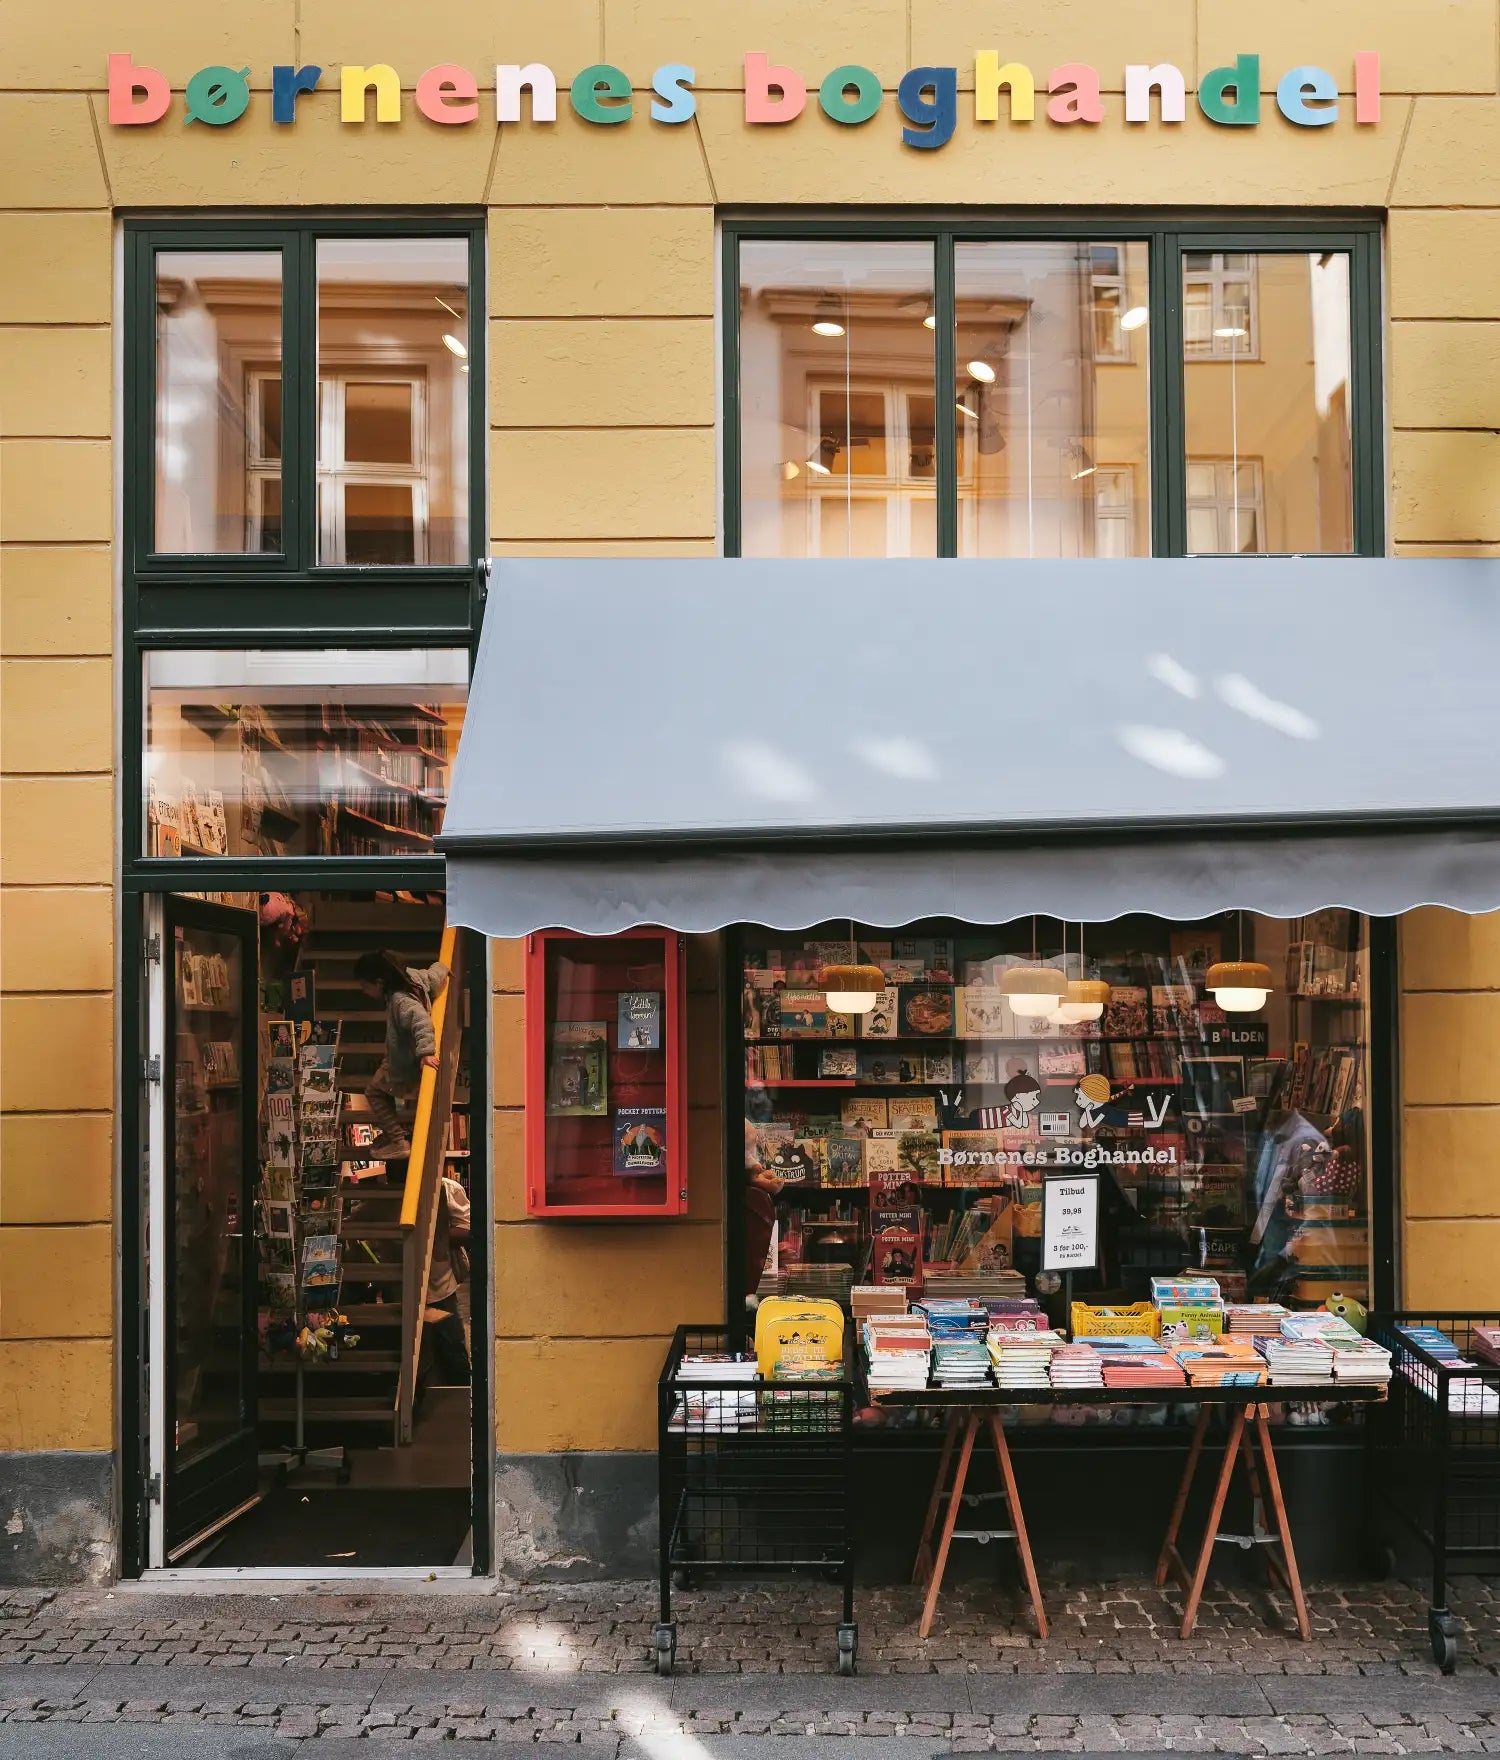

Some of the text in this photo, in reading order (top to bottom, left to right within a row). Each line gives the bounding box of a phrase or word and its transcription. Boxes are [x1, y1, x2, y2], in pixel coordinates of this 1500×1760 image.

[108, 50, 1380, 148] børnenes boghandel
[937, 1147, 1048, 1165] Børnenes
[1053, 1145, 1177, 1168] Boghandel
[878, 1173, 912, 1181] POTTER
[883, 1181, 905, 1190] MIN
[1059, 1187, 1085, 1196] Tilbud
